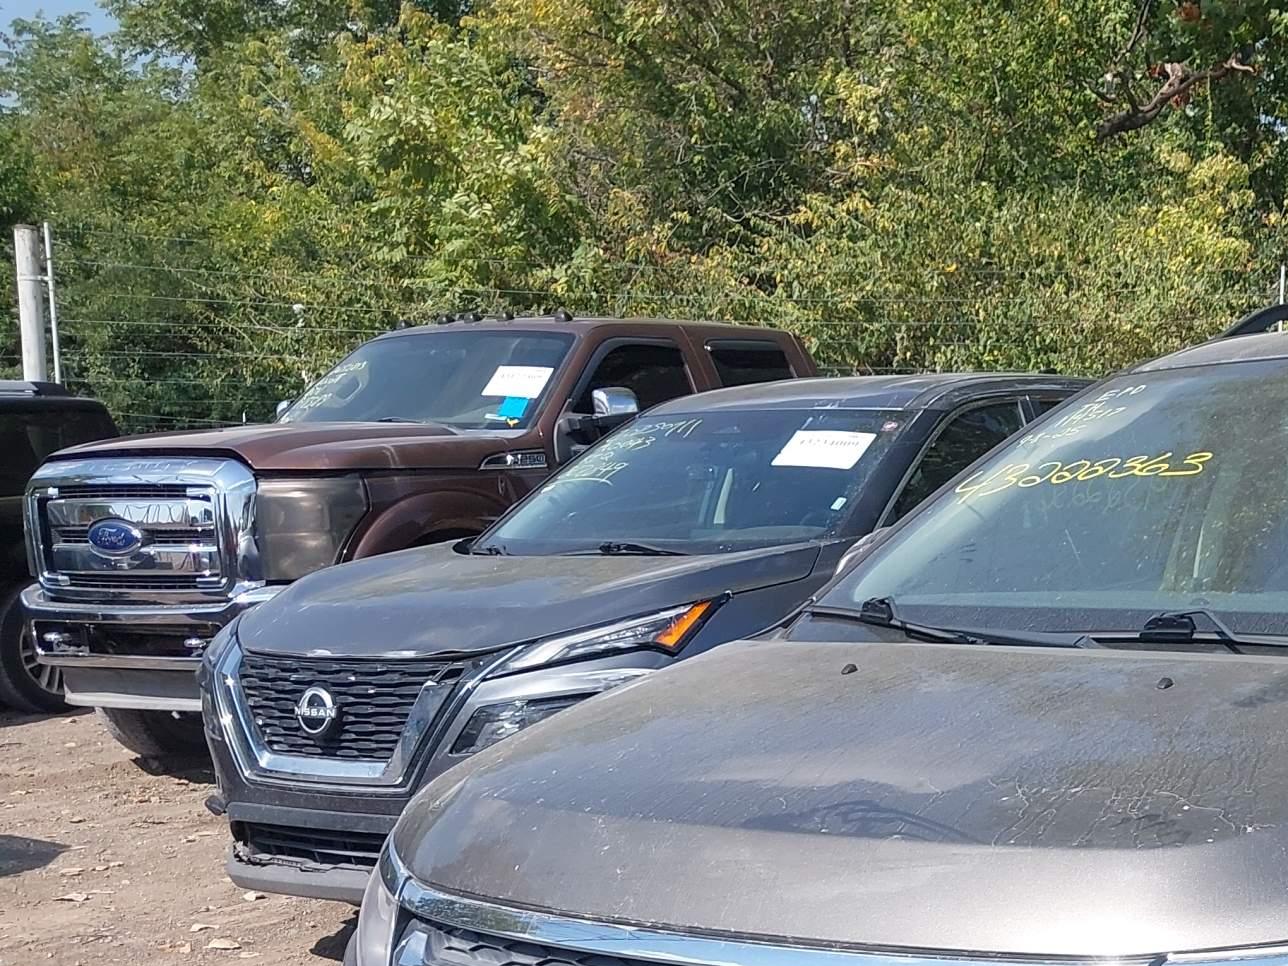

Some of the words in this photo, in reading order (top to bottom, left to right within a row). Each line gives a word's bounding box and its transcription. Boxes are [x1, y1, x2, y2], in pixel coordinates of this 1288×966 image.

[955, 451, 1213, 505] 43222363
[97, 527, 127, 546] Ford
[294, 705, 336, 718] NISSAN
